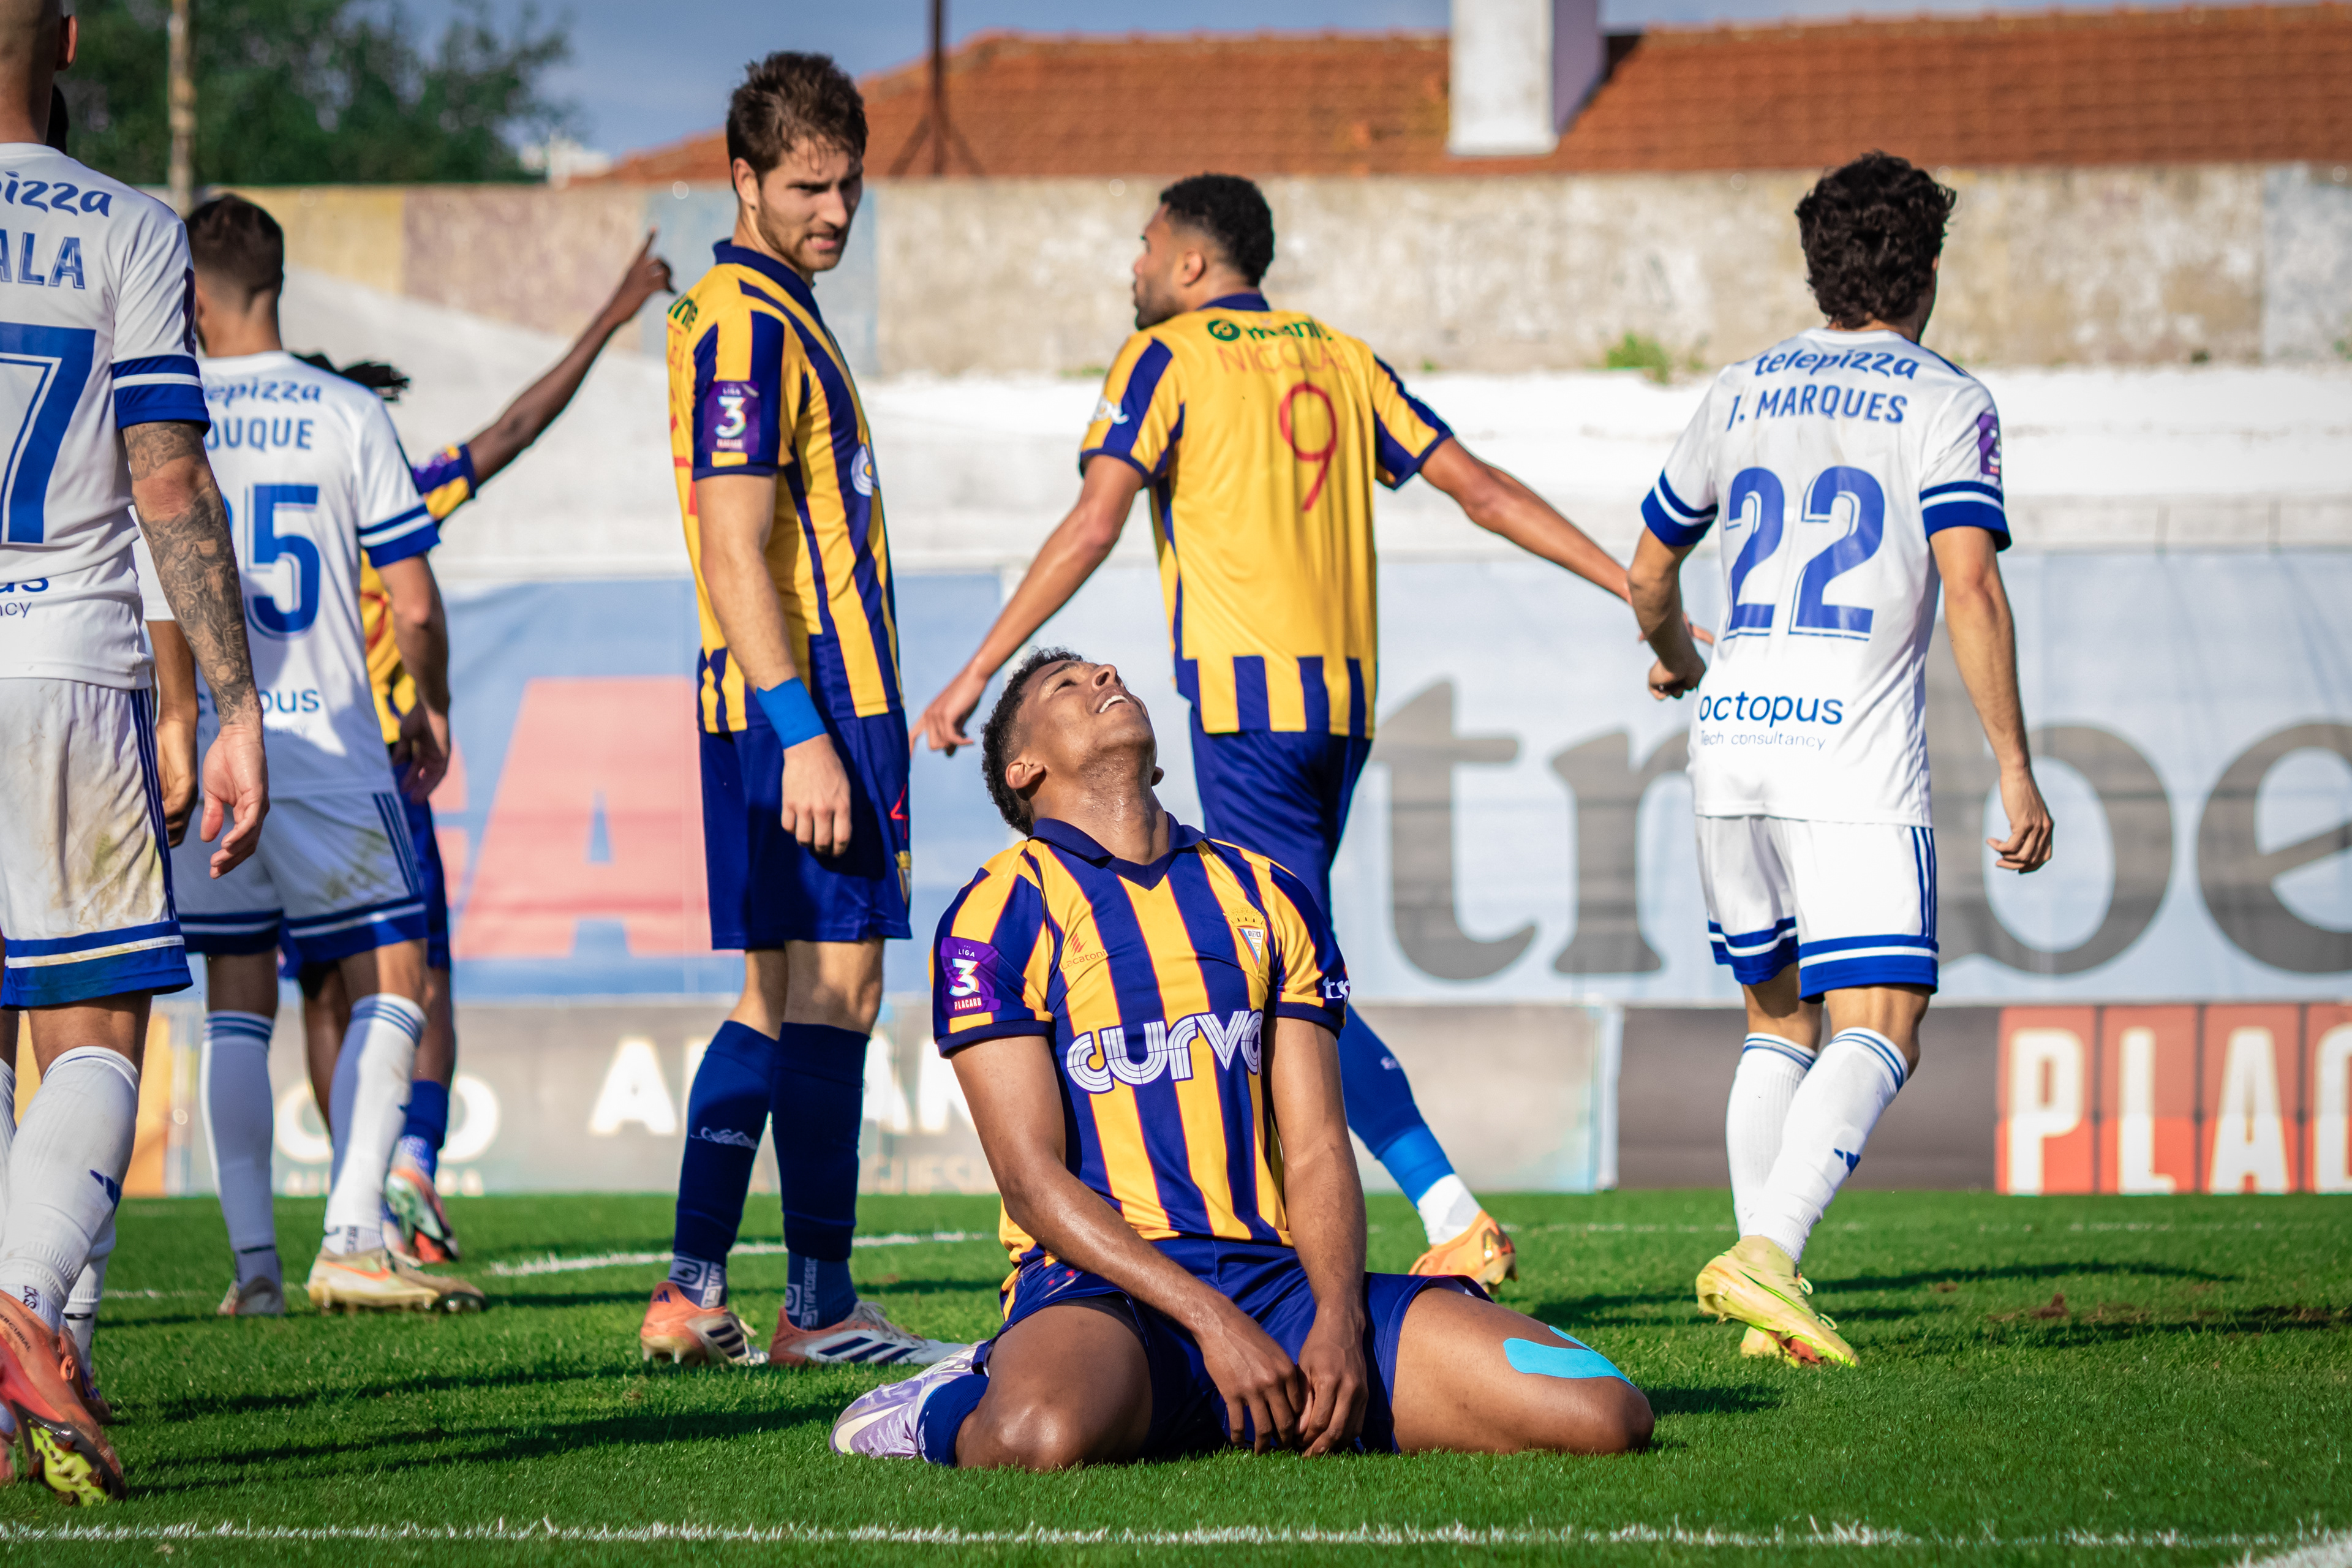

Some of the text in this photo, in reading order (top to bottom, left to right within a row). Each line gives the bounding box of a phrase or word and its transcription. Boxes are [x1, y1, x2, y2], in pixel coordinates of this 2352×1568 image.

[0, 170, 113, 217] izza
[1754, 349, 1920, 380] telepizza
[203, 377, 322, 409] epizza
[1754, 383, 1908, 424] MARQUES
[714, 396, 747, 439] 3
[1279, 381, 1338, 513] 9
[222, 483, 321, 641] 5
[1721, 465, 1886, 643] 22
[1700, 691, 1844, 728] octopus
[1731, 731, 1826, 751] consultancy
[958, 949, 975, 957] LIGA
[1060, 950, 1106, 971] Lacatoni
[949, 958, 981, 997] 3
[954, 997, 982, 1011] PLACARD
